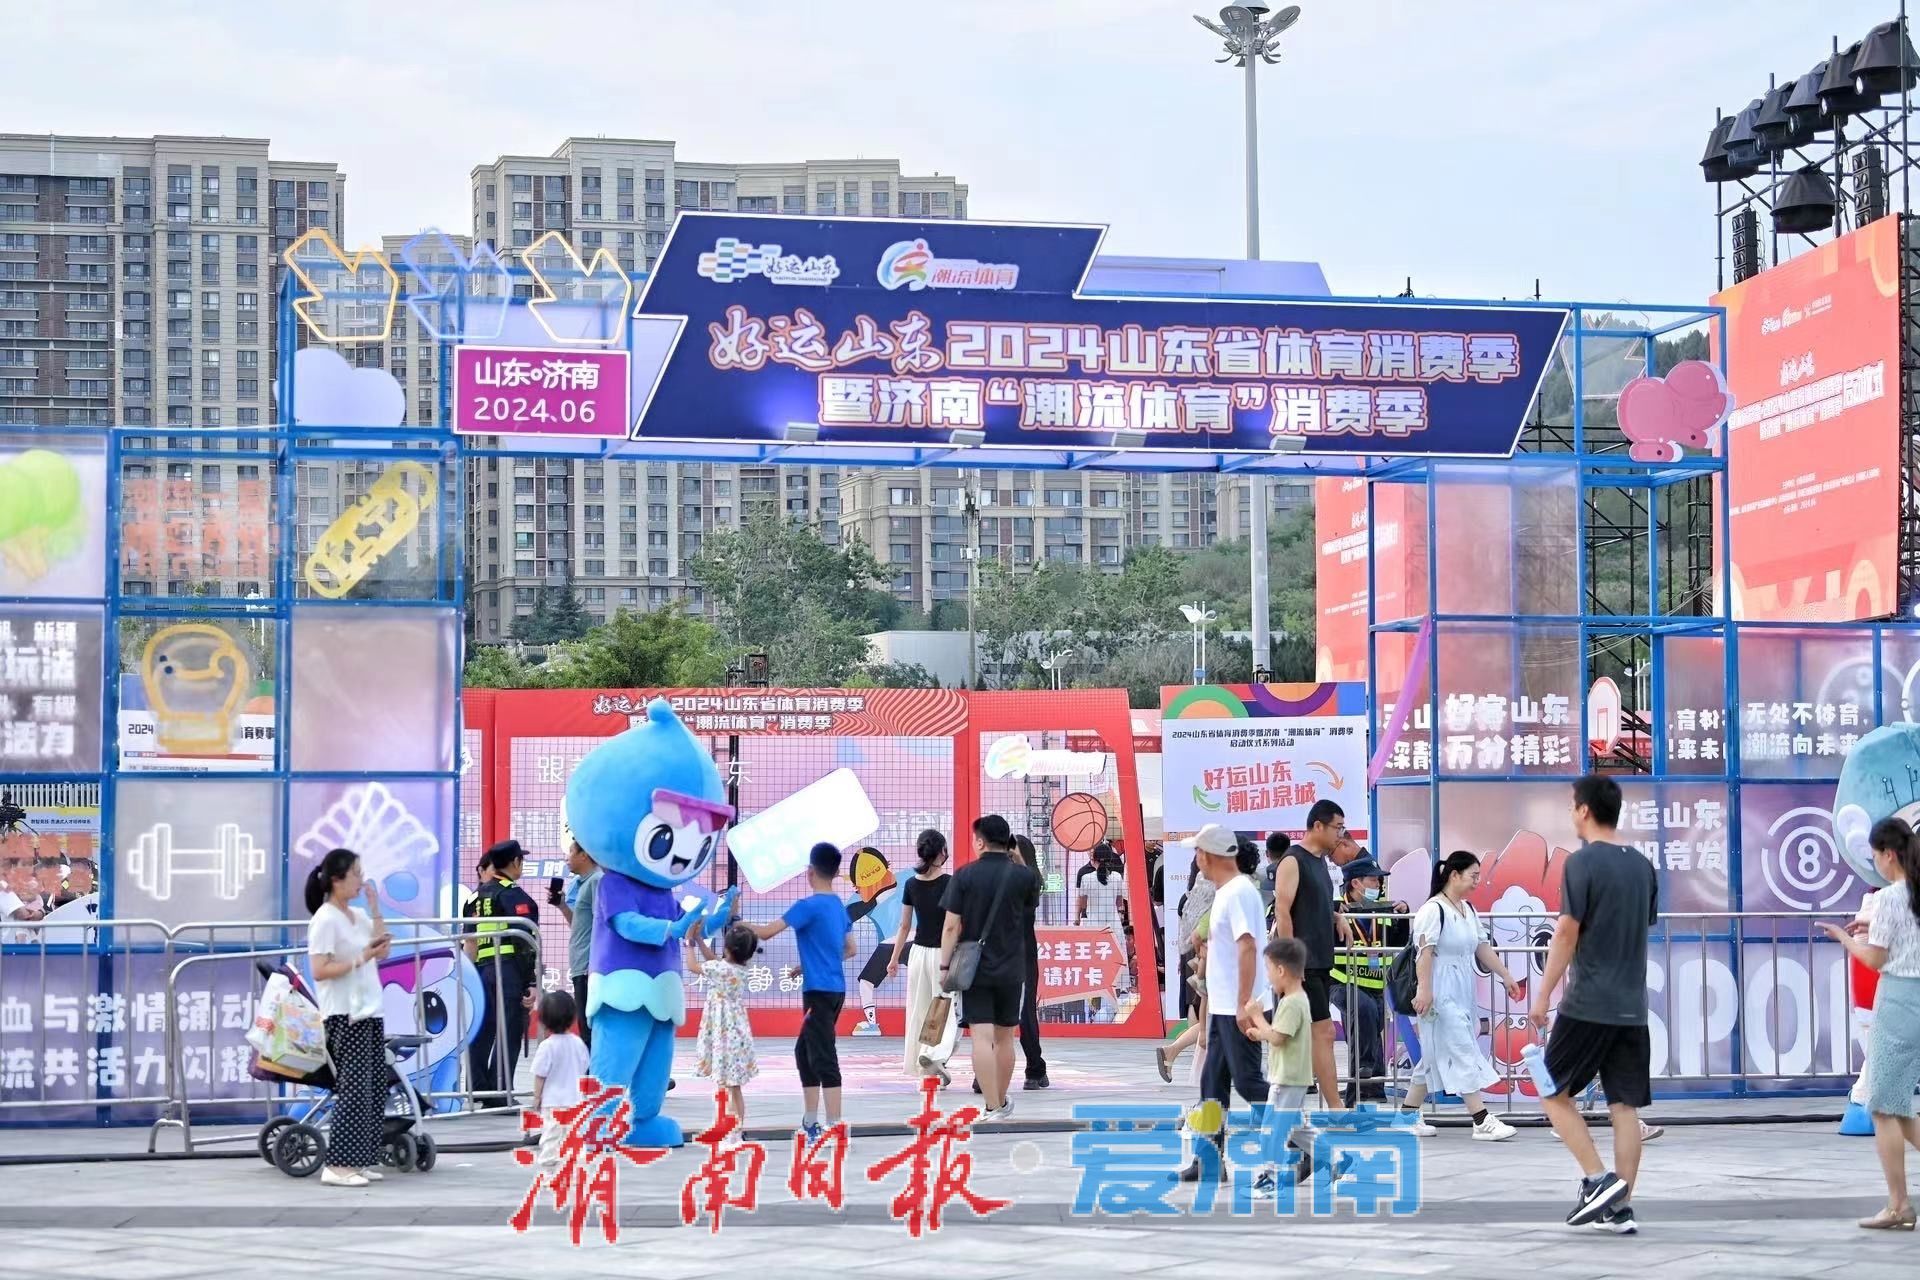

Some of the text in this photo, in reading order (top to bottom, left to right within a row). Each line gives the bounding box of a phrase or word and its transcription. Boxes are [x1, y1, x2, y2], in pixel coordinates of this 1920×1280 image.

[930, 266, 1015, 286] 潮流体育
[710, 307, 1519, 381] 好运山东2024山东省体育消费季
[819, 375, 1427, 433] 暨济南“潮流体育”消费季
[128, 723, 275, 739] 2024 育赛事
[1203, 760, 1292, 791] 好运山东
[1226, 781, 1317, 814] 潮动泉城
[1037, 941, 1113, 961] 公主王子
[1043, 967, 1103, 987] 请打卡
